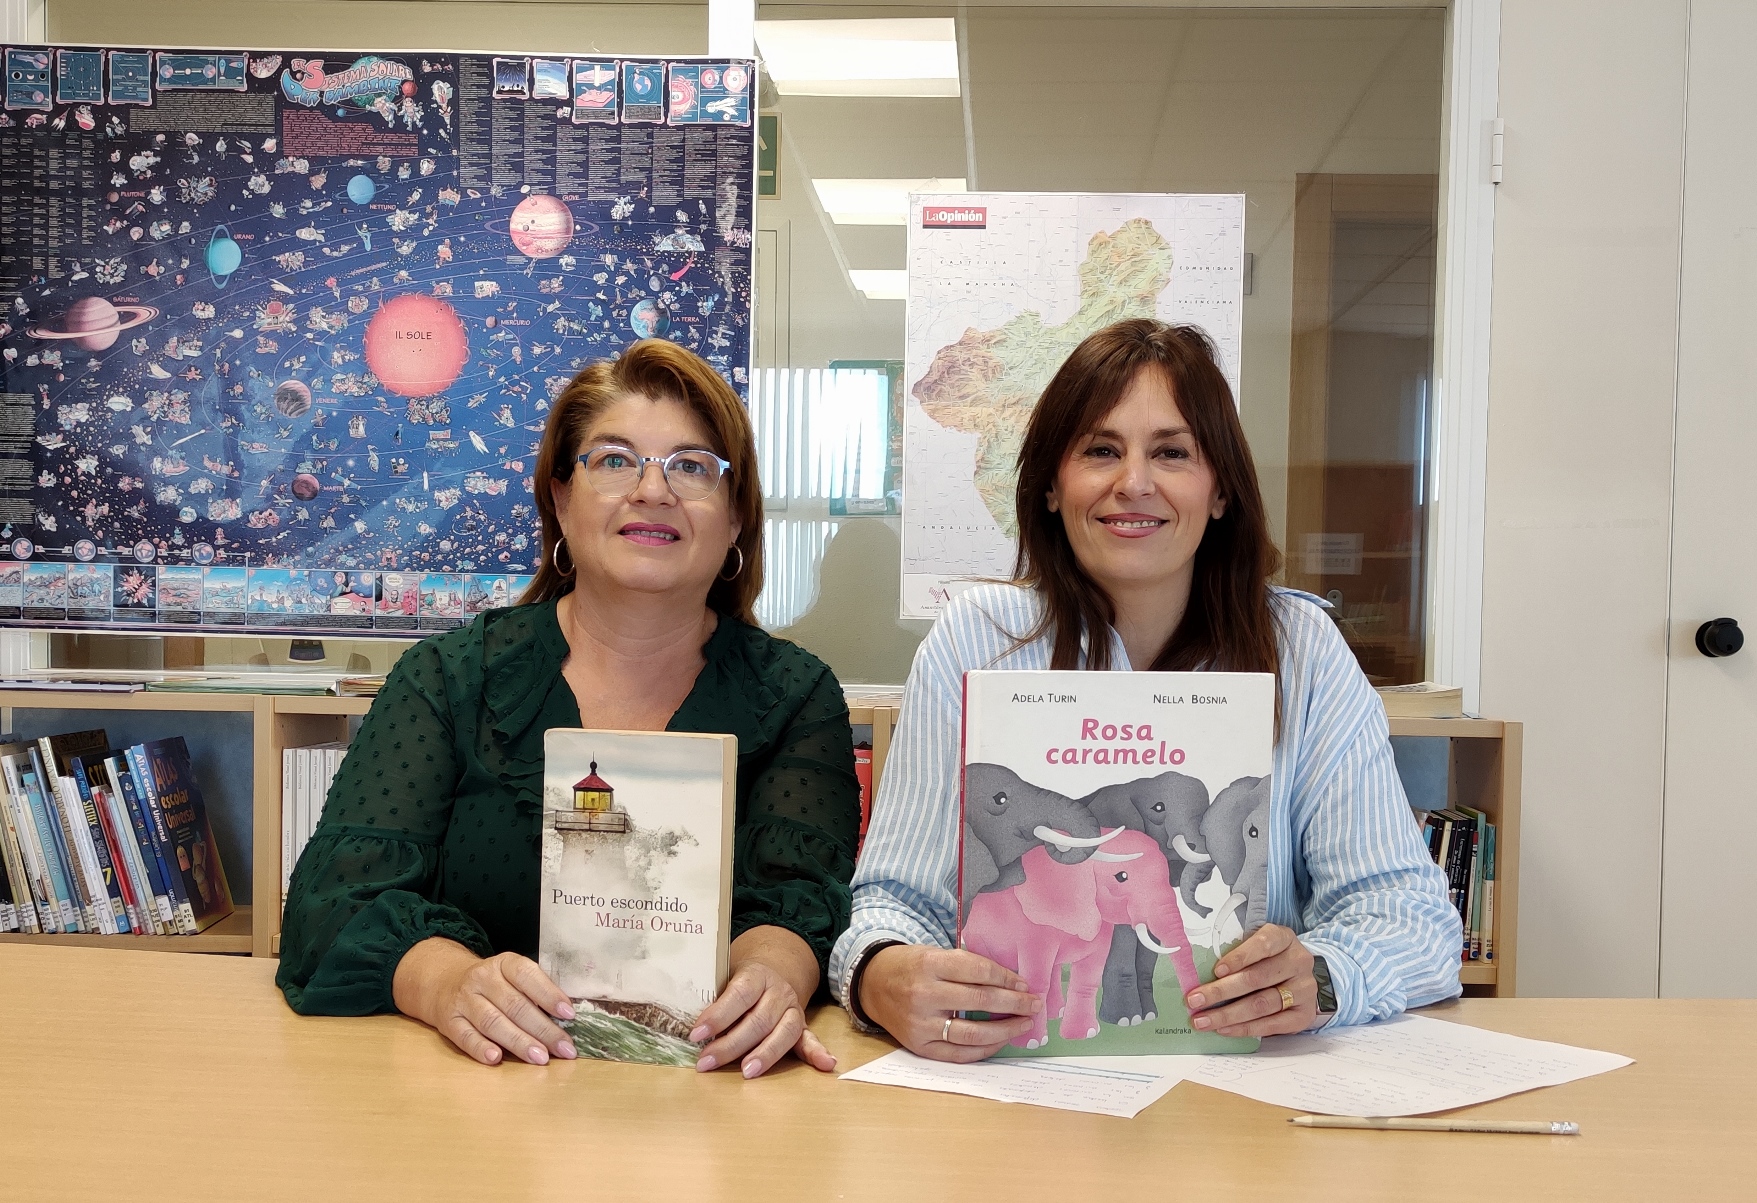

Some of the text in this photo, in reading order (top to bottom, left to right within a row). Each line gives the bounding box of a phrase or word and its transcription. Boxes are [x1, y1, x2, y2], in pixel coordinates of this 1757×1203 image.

[370, 60, 413, 80] SOLARE
[281, 69, 402, 107] PER BAMBINI
[925, 209, 983, 224] LaOpinión
[395, 331, 432, 340] IL SOLE
[1080, 718, 1154, 741] Rosa
[1045, 740, 1187, 765] caramelo
[160, 787, 189, 809] escolar
[144, 778, 157, 808] escolar
[153, 809, 168, 842] Universal
[165, 804, 196, 829] Universal
[551, 888, 689, 913] Puerto escondido
[594, 911, 705, 935] María Oruña
[1155, 1027, 1192, 1035] kalandraka
